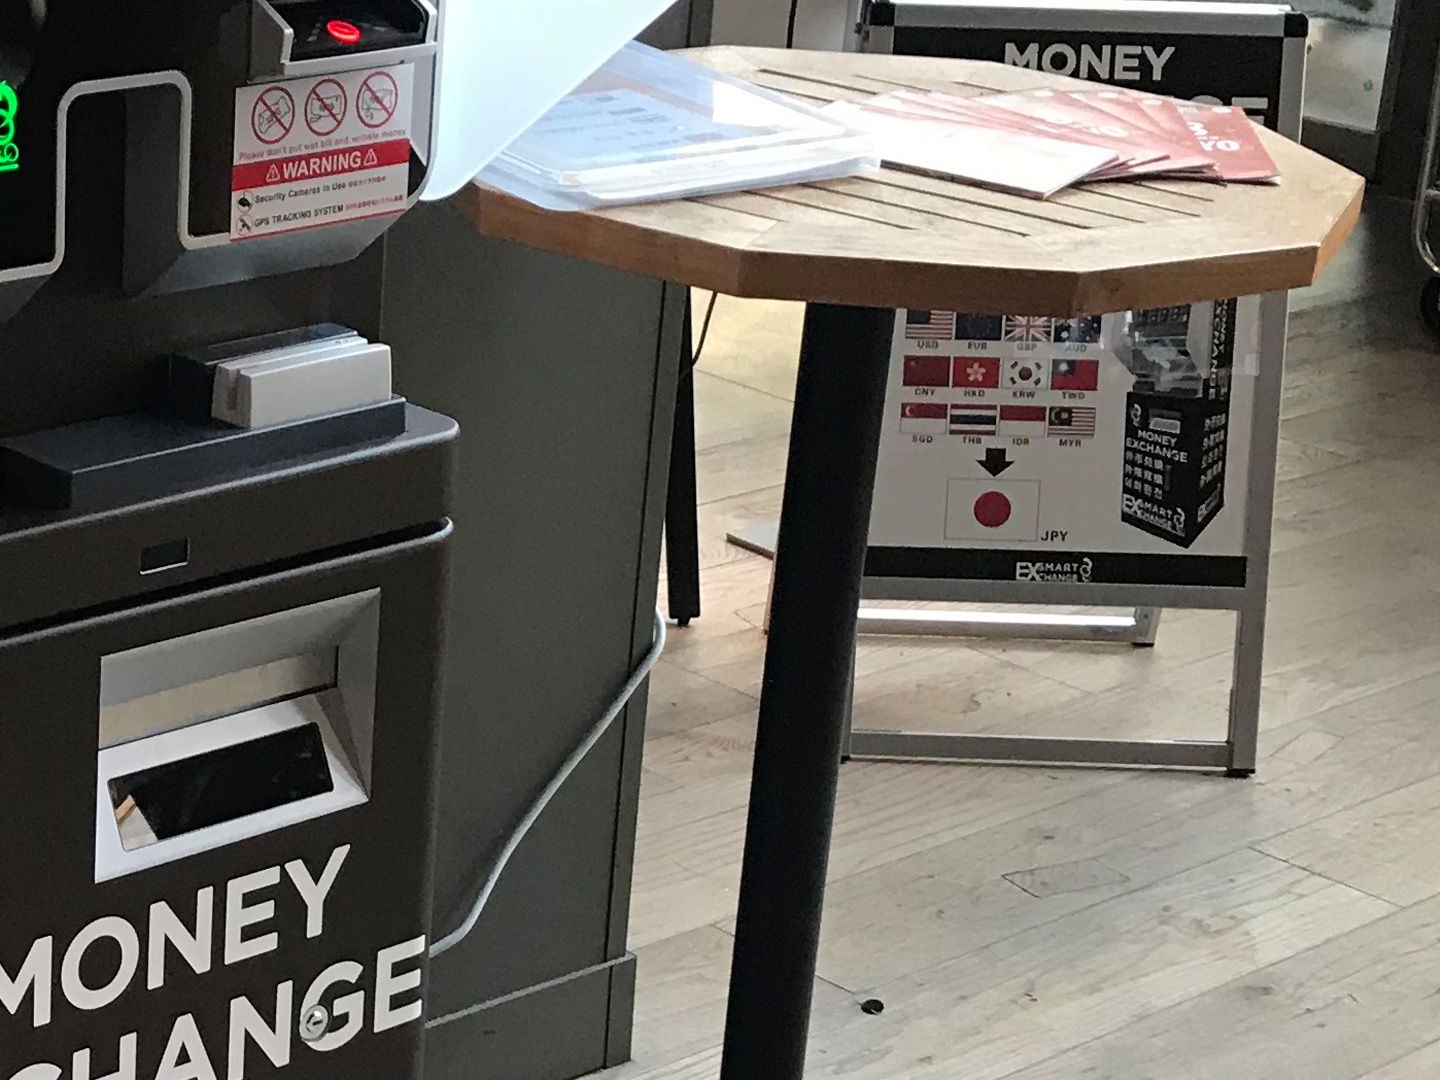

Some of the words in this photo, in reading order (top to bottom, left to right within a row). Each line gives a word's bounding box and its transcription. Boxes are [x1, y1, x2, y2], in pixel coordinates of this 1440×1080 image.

[1004, 42, 1176, 81] MONEY
[282, 150, 361, 179] WARNING
[254, 191, 286, 204] Security
[288, 187, 320, 197] Cameras
[332, 182, 346, 191] Use
[254, 217, 270, 227] GPS
[271, 210, 311, 224] TRACKING
[313, 204, 344, 217] SYSTEM
[1138, 429, 1177, 447] MONEY
[1126, 437, 1188, 462] EXCHANGE
[1041, 530, 1069, 542] JPY
[1039, 562, 1078, 572] SMART
